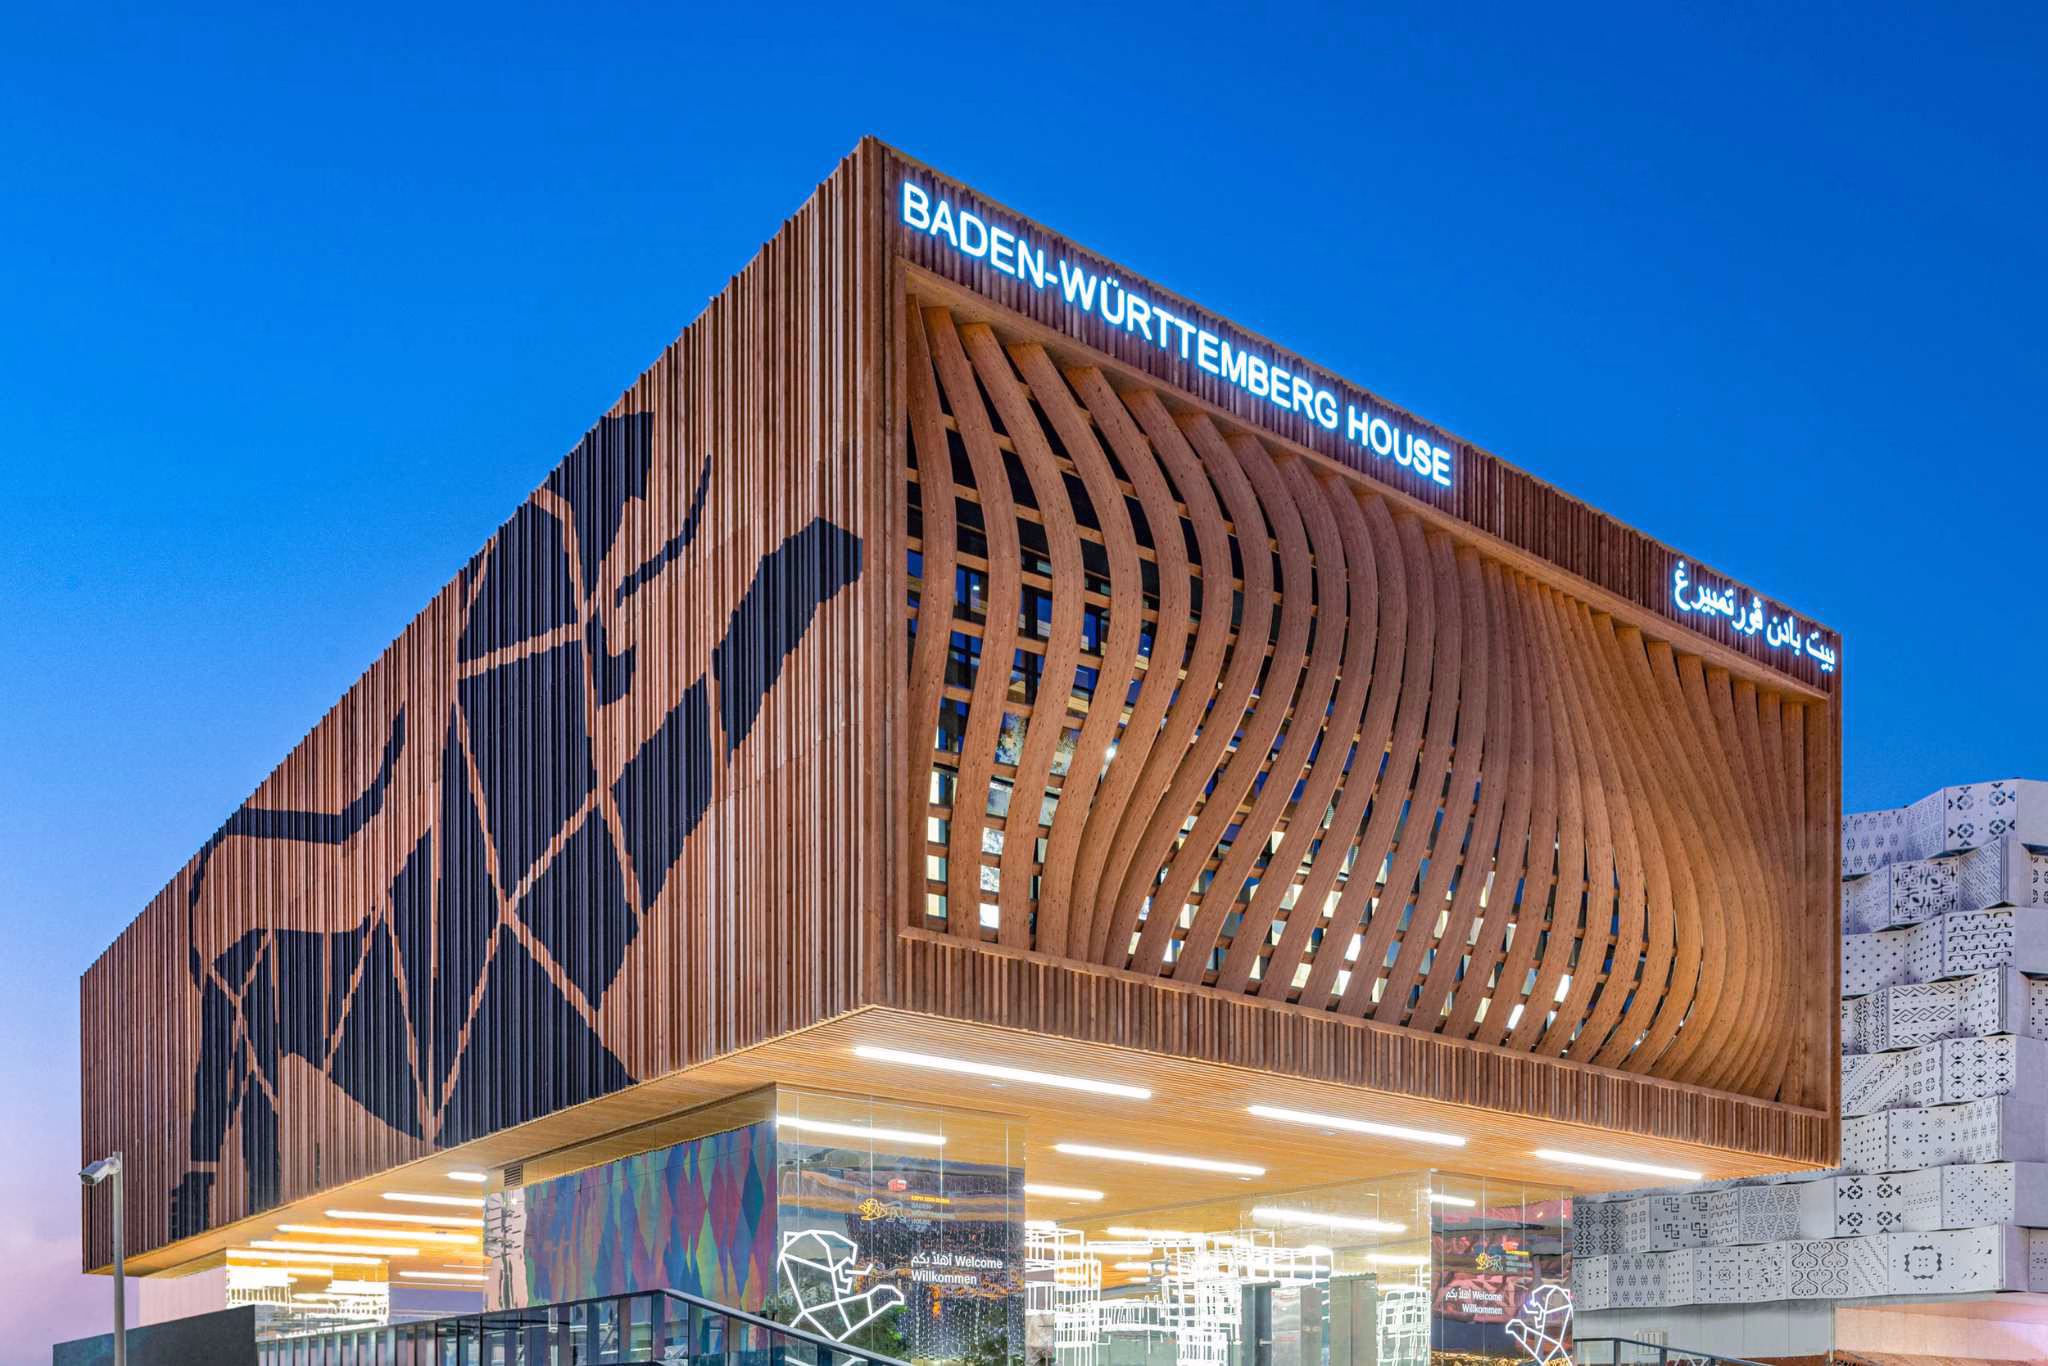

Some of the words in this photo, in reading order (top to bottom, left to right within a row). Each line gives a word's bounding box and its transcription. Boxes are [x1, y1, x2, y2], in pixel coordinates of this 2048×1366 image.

[903, 182, 1338, 430] BADEN-WÜRTTEMBERG
[1348, 405, 1451, 487] HOUSE
[1766, 616, 1801, 656] بادن
[1806, 631, 1836, 672] بيت
[955, 1255, 1003, 1269] Welcome
[911, 1269, 977, 1285] Willkommen
[1472, 1290, 1504, 1301] Welcome
[1462, 1303, 1503, 1315] Willkommen
